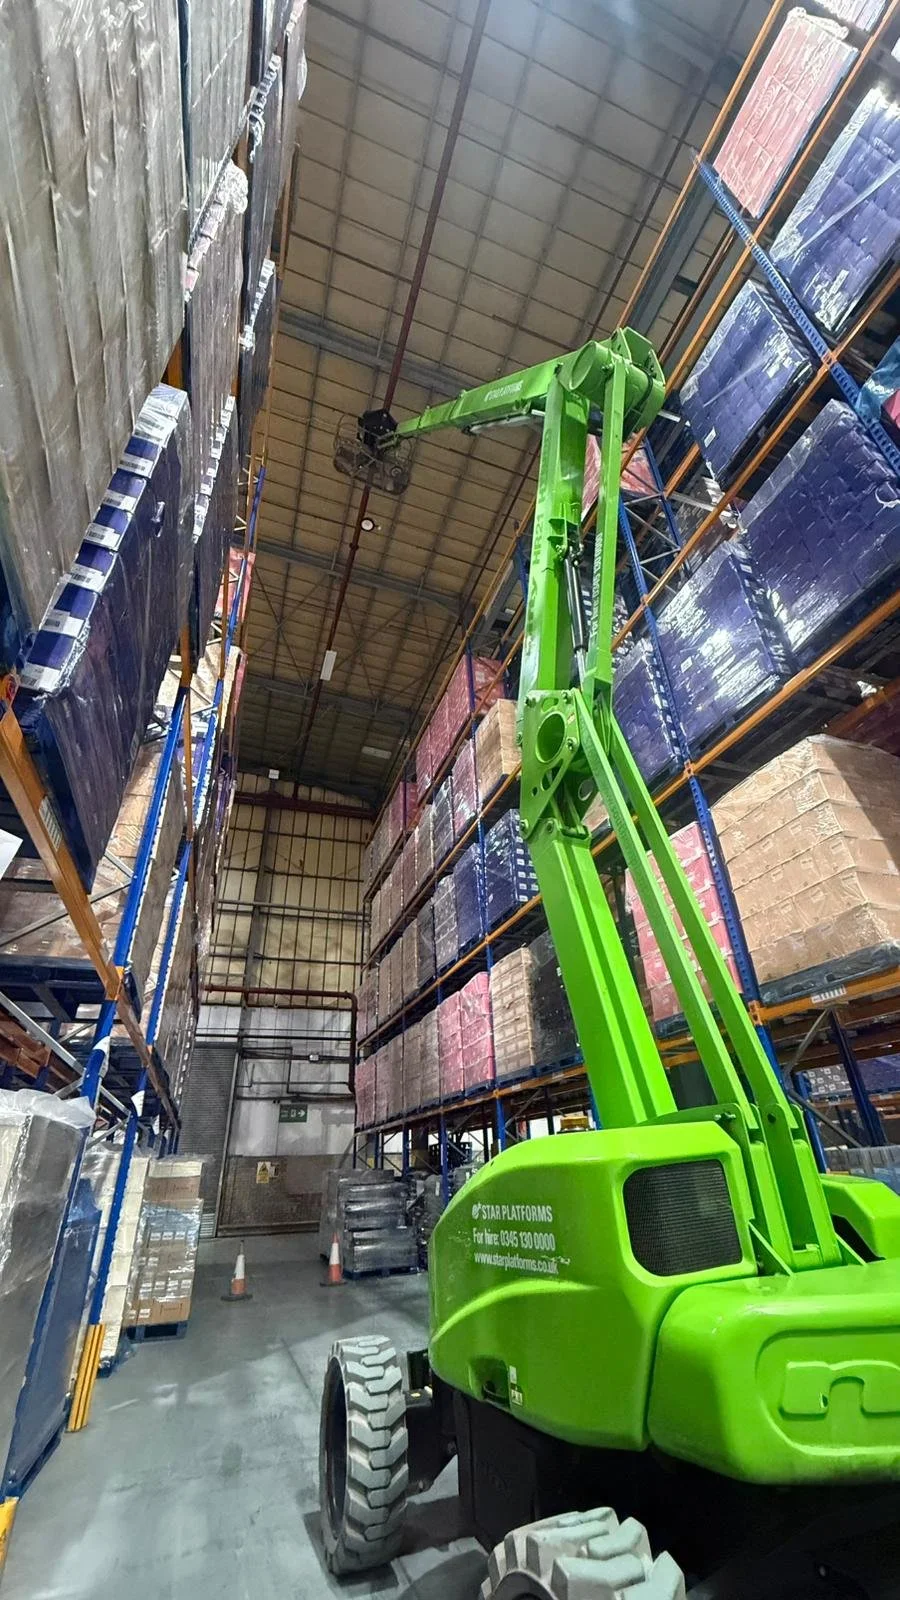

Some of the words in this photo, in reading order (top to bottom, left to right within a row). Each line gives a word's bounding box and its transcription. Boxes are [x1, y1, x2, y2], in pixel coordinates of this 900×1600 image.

[482, 1204, 501, 1220] STAR
[501, 1204, 553, 1222] PLATFORMS
[473, 1227, 484, 1244] For
[484, 1228, 500, 1246] hire:
[500, 1229, 519, 1248] 0345
[519, 1231, 533, 1249] 130
[533, 1232, 556, 1251] 0000
[474, 1252, 559, 1274] www.starplatforms.co.uk
